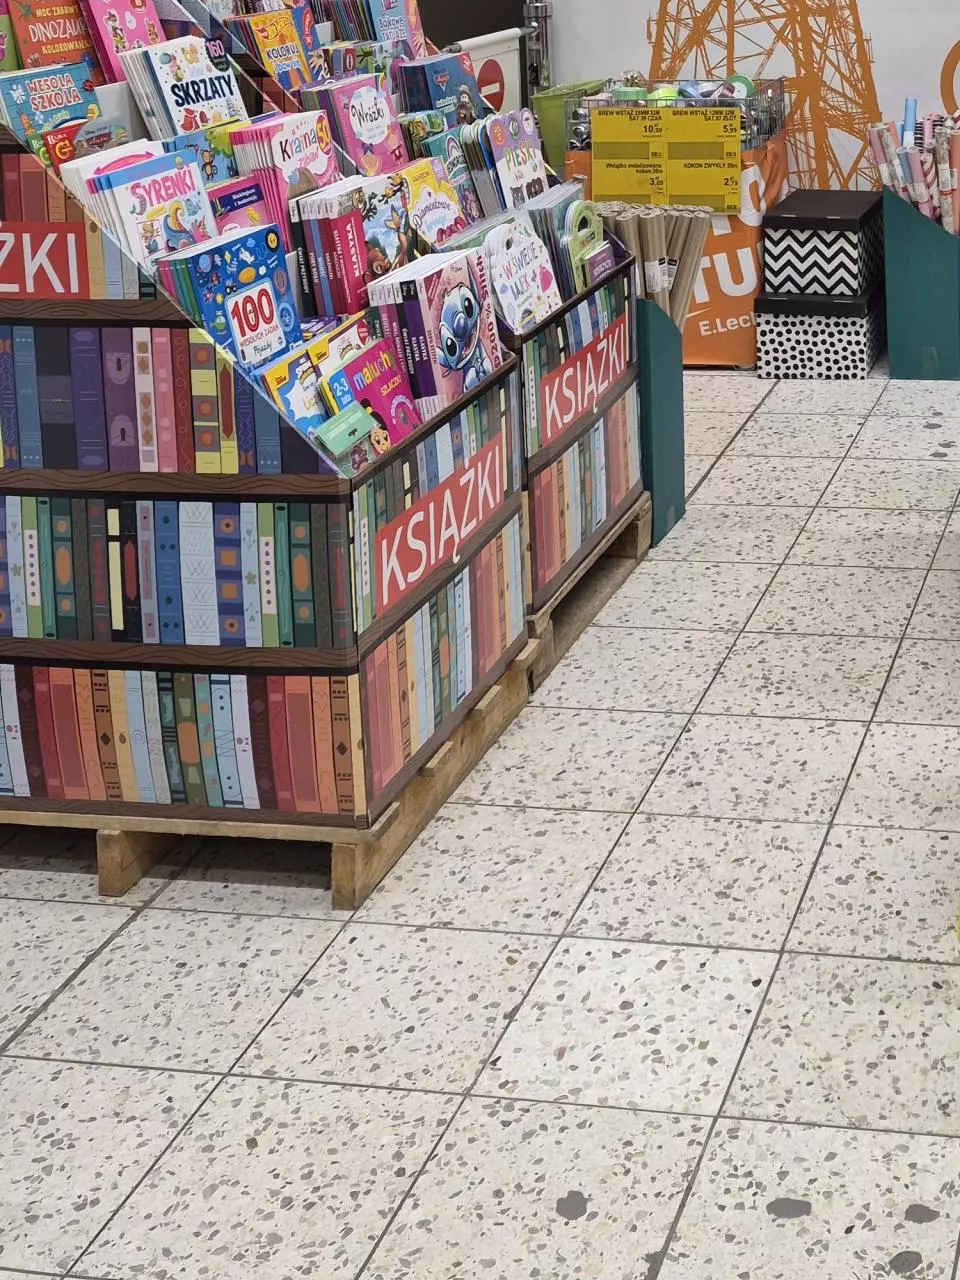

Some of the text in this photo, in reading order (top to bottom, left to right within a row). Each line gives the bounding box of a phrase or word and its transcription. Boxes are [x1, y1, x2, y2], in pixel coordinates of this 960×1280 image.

[207, 39, 225, 58] 160
[265, 42, 299, 61] KOLORUJ
[170, 74, 235, 107] SKRZATY
[350, 97, 385, 128] Wróżki
[279, 127, 317, 160] Kraina
[317, 124, 330, 148] 50
[503, 142, 537, 172] PIESKI
[130, 165, 196, 216] SYRENKI
[345, 222, 360, 278] KLASYKA
[476, 255, 489, 301] Stitch
[231, 288, 275, 338] 100
[411, 336, 419, 362] KLASYKA
[419, 335, 428, 361] KLASYKA
[487, 321, 500, 352] 200
[334, 377, 349, 397] 2-3
[544, 322, 626, 440] KSIĄŻKI
[381, 444, 500, 606] KSIĄŻKI
